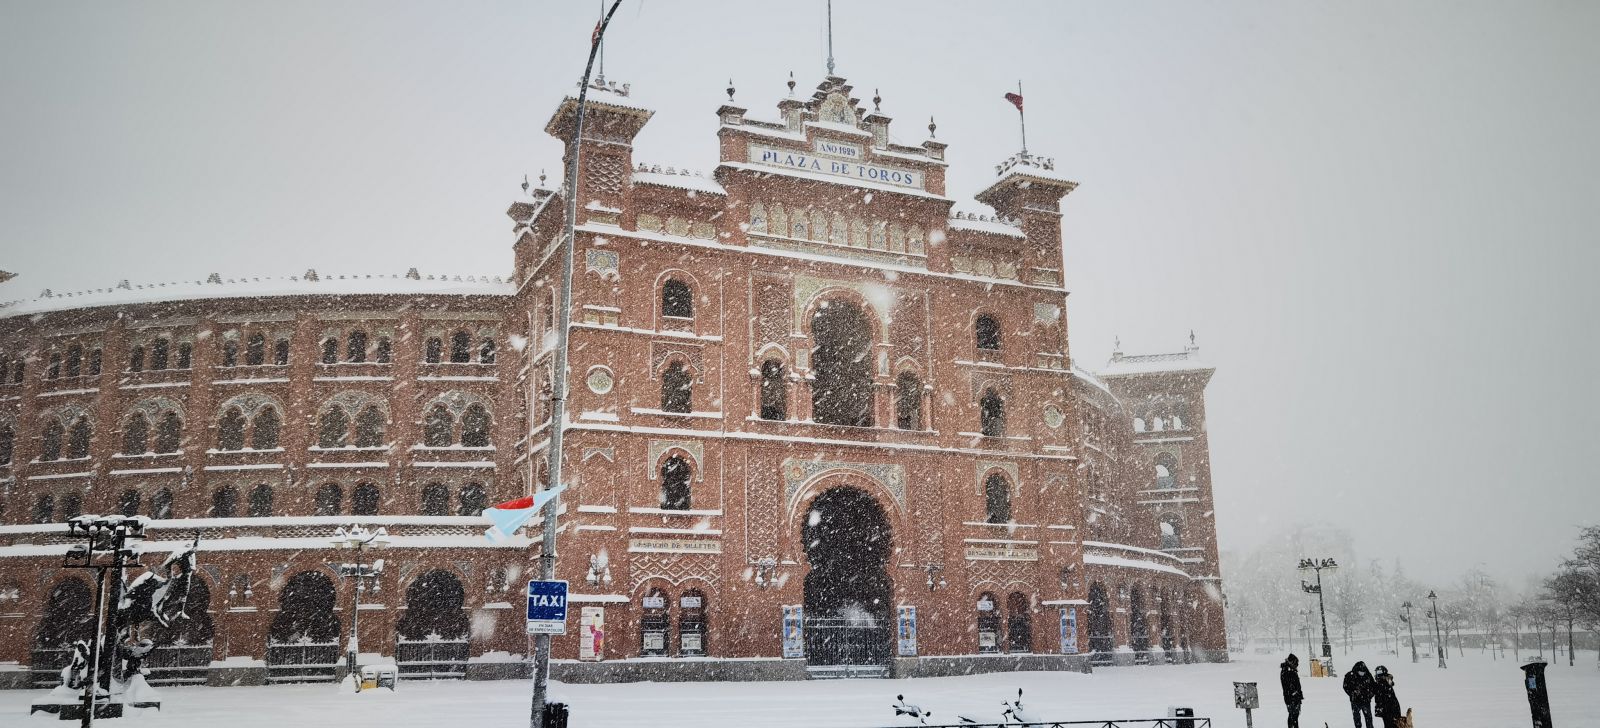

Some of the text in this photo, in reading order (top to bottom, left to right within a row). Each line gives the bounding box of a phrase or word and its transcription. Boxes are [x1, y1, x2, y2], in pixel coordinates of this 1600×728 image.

[762, 151, 913, 184] PLAZA DE TOROS
[530, 594, 564, 608] TAXI
